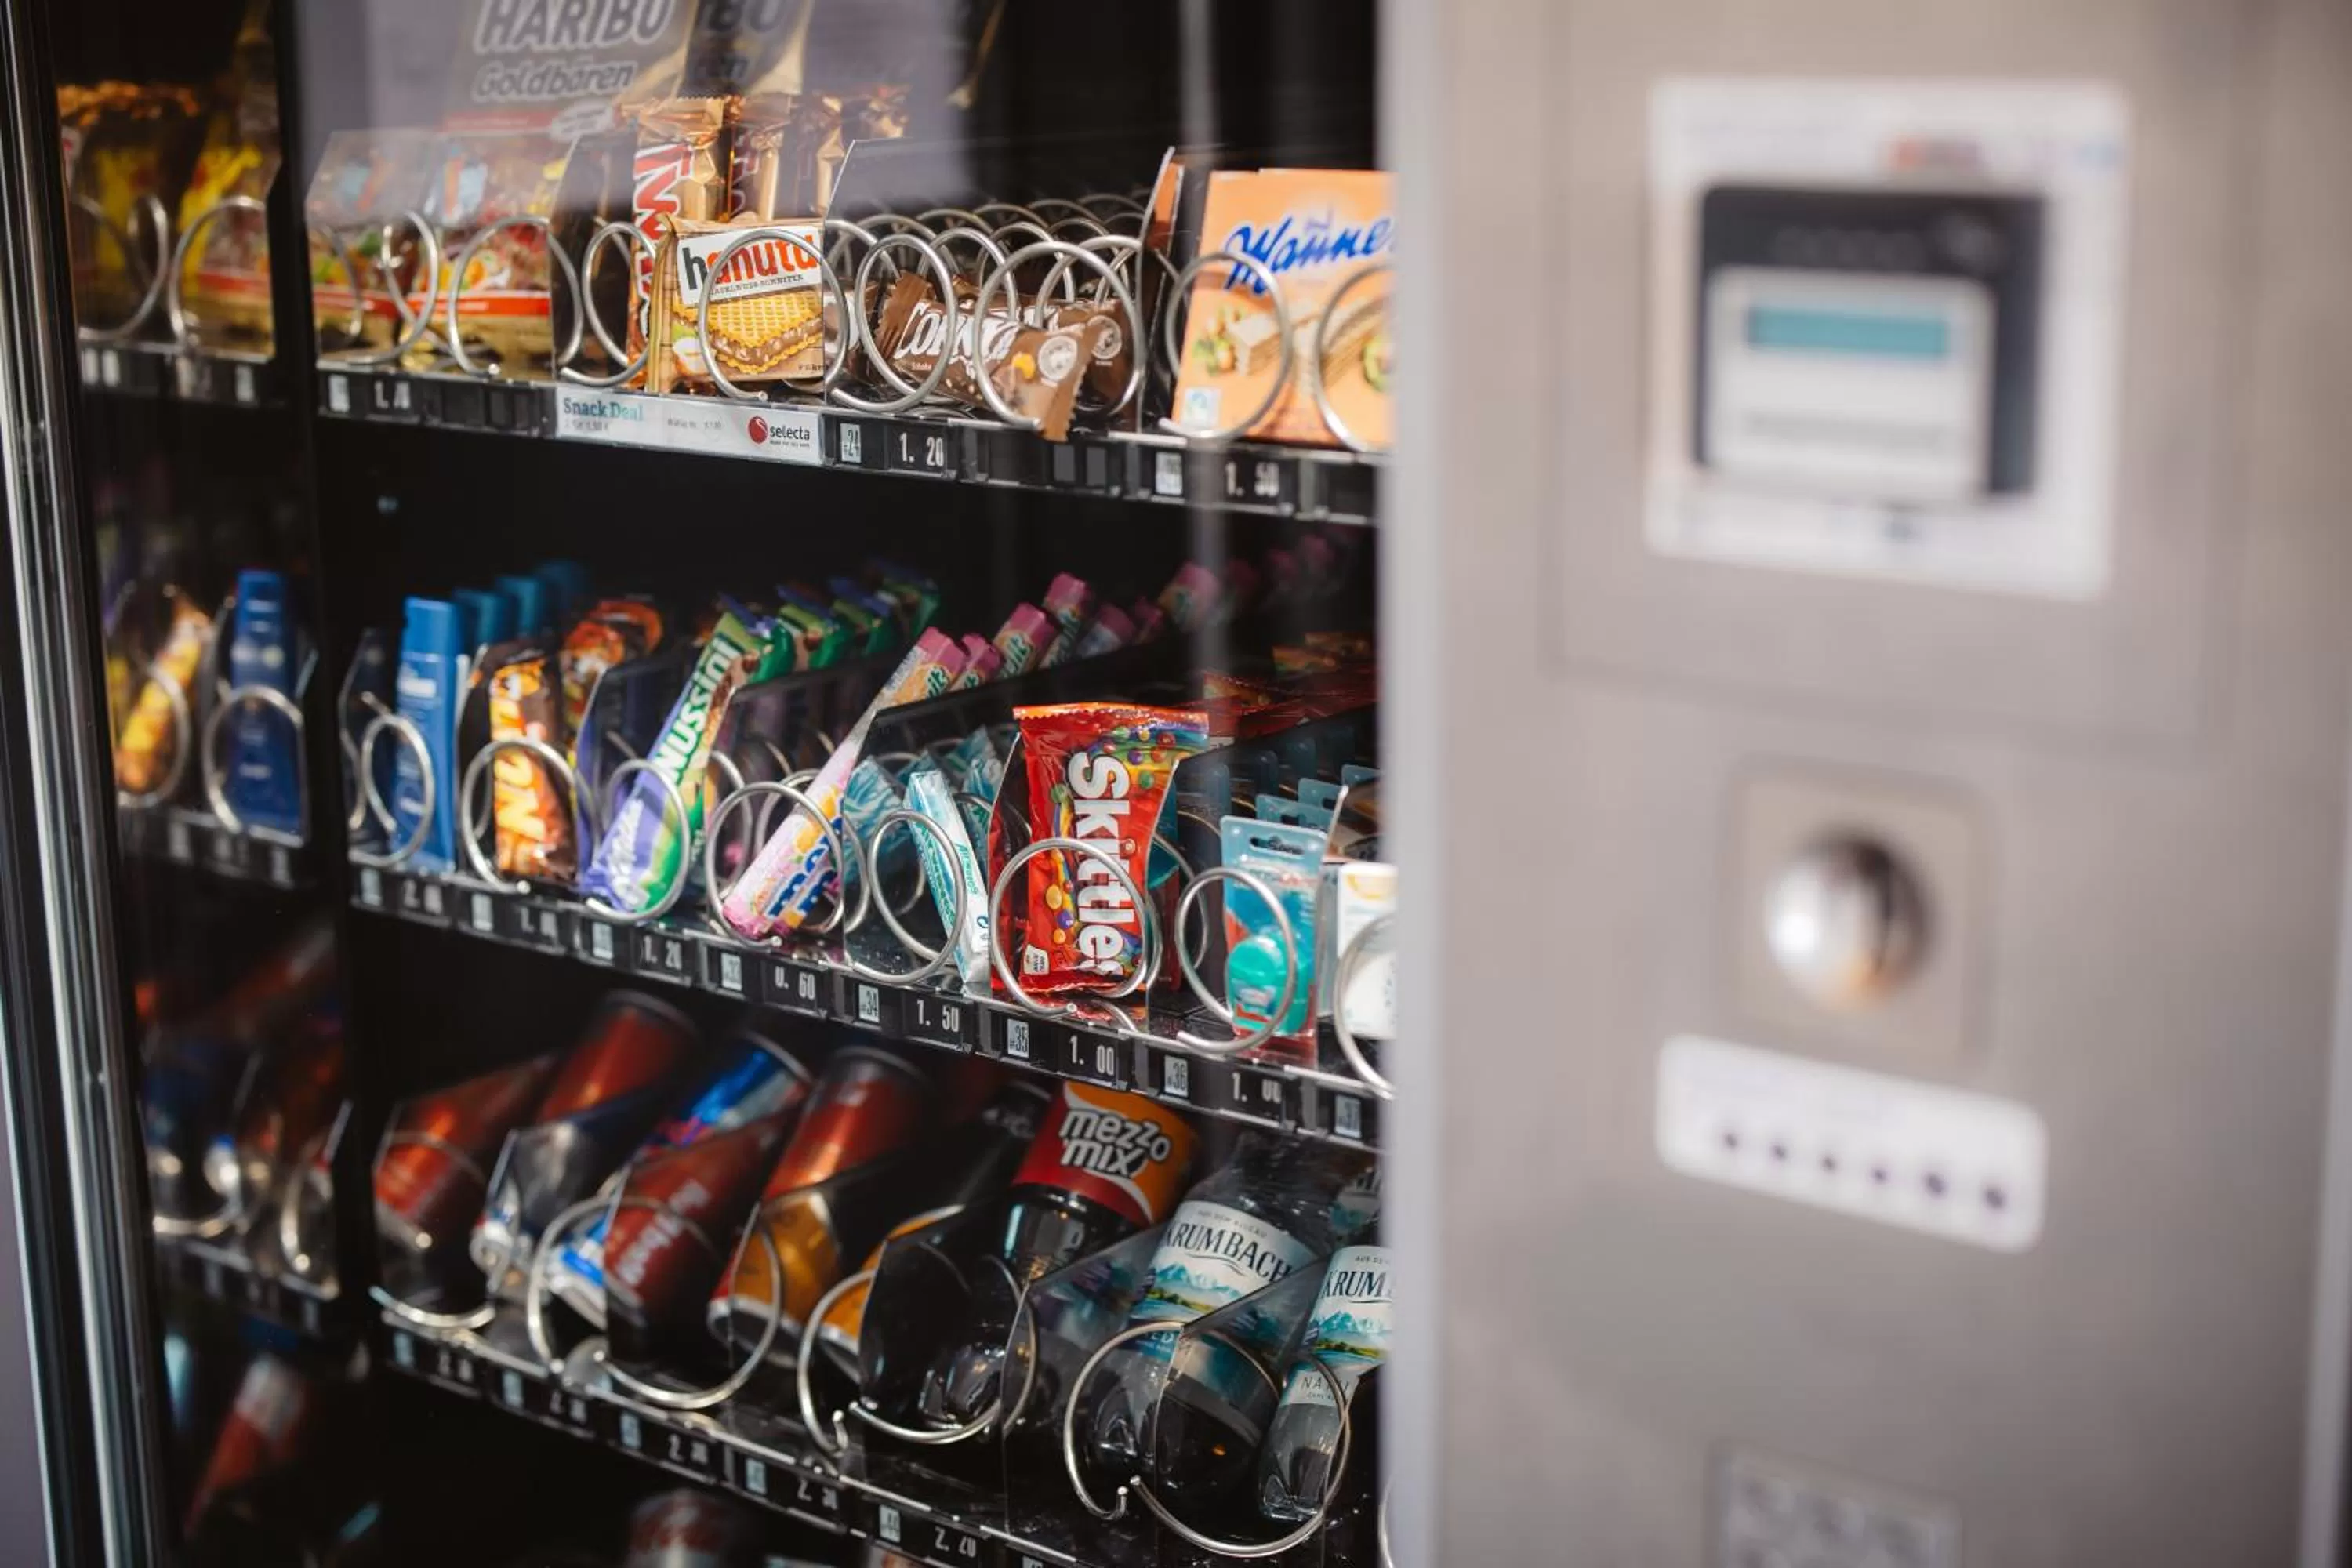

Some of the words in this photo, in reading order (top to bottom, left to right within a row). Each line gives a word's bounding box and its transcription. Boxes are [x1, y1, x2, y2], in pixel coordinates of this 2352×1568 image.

[474, 0, 676, 54] HARIBO
[682, 234, 819, 291] hanuta
[1224, 217, 1393, 295] Manne
[563, 397, 608, 417] Snack
[609, 401, 644, 422] Deal
[769, 424, 810, 441] selecta
[1058, 1110, 1171, 1161] mezzo
[1059, 1139, 1145, 1176] mix
[1321, 1270, 1392, 1299] KRUM
